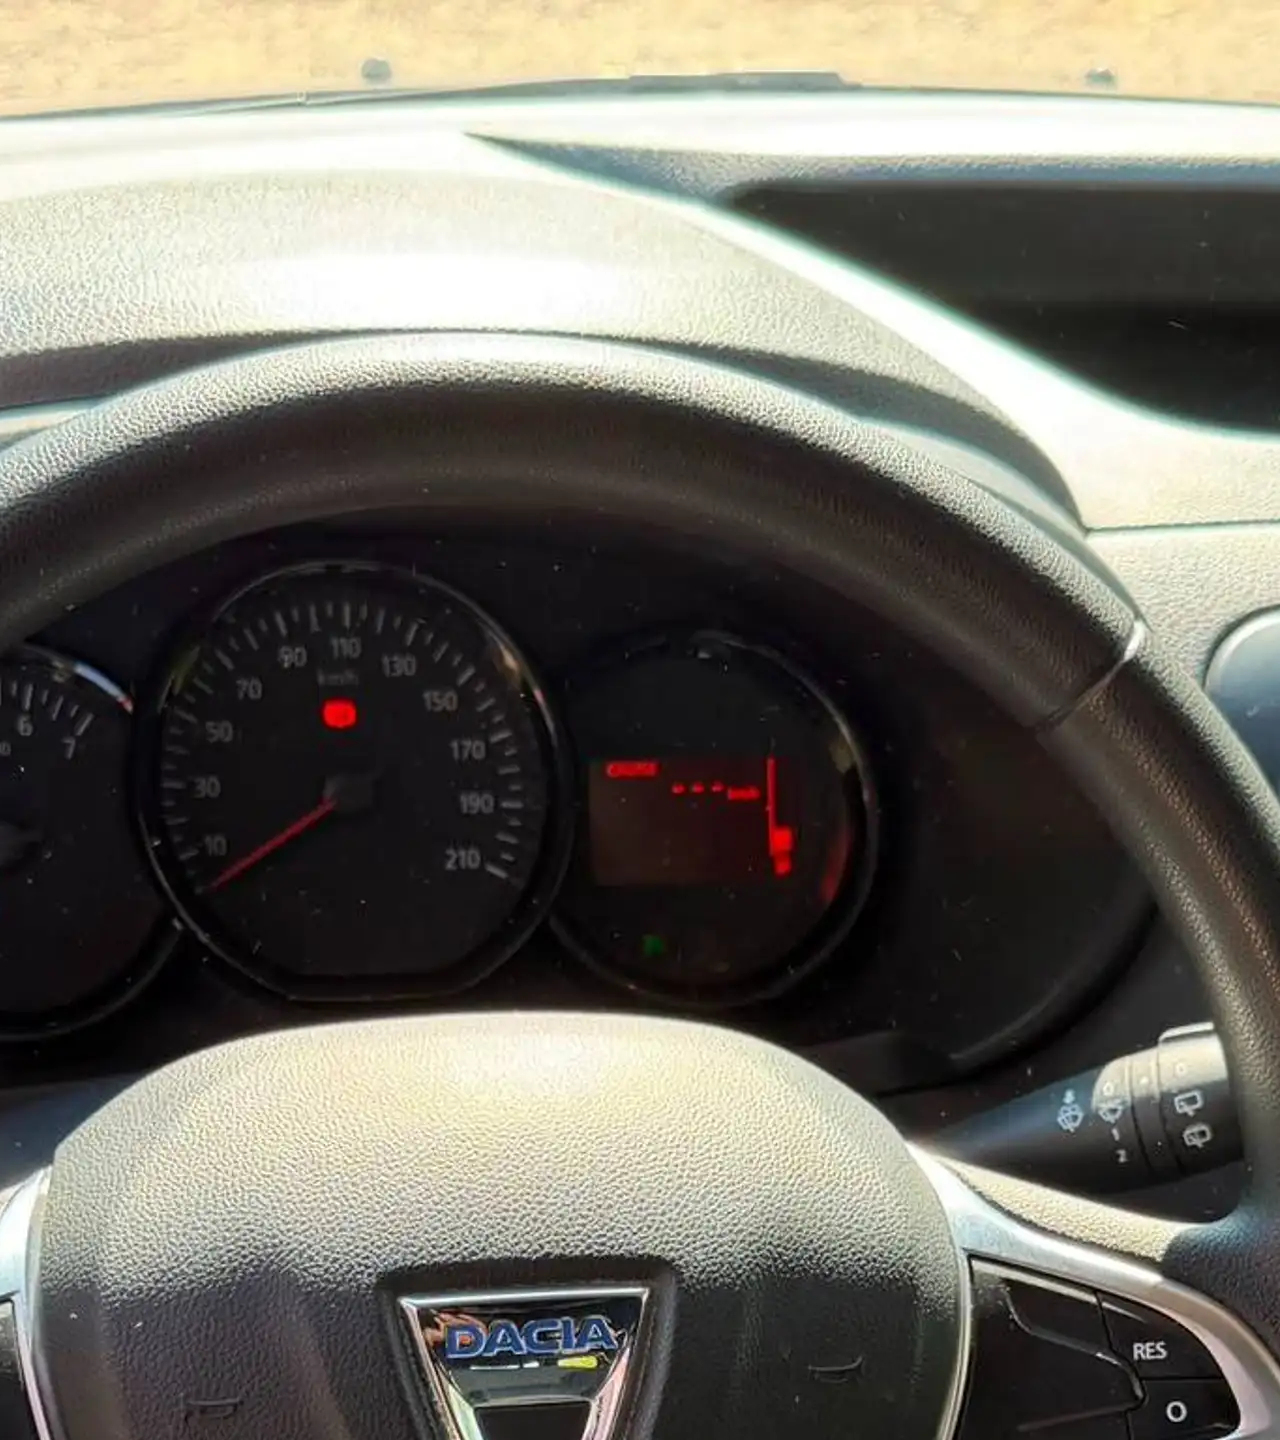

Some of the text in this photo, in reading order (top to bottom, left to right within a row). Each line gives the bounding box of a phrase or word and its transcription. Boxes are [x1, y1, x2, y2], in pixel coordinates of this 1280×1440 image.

[278, 646, 307, 667] 90
[330, 638, 361, 659] 110
[381, 656, 416, 676] 130
[236, 679, 263, 700] 70
[422, 691, 458, 712] 150
[16, 712, 33, 736] 6
[205, 721, 233, 743] 50
[61, 736, 77, 760] 7
[450, 740, 486, 761] 170
[194, 776, 221, 798] 30
[459, 793, 495, 814] 190
[204, 835, 228, 856] 10
[445, 849, 481, 870] 210
[443, 1314, 619, 1359] DACIA
[1132, 1340, 1168, 1361] RES
